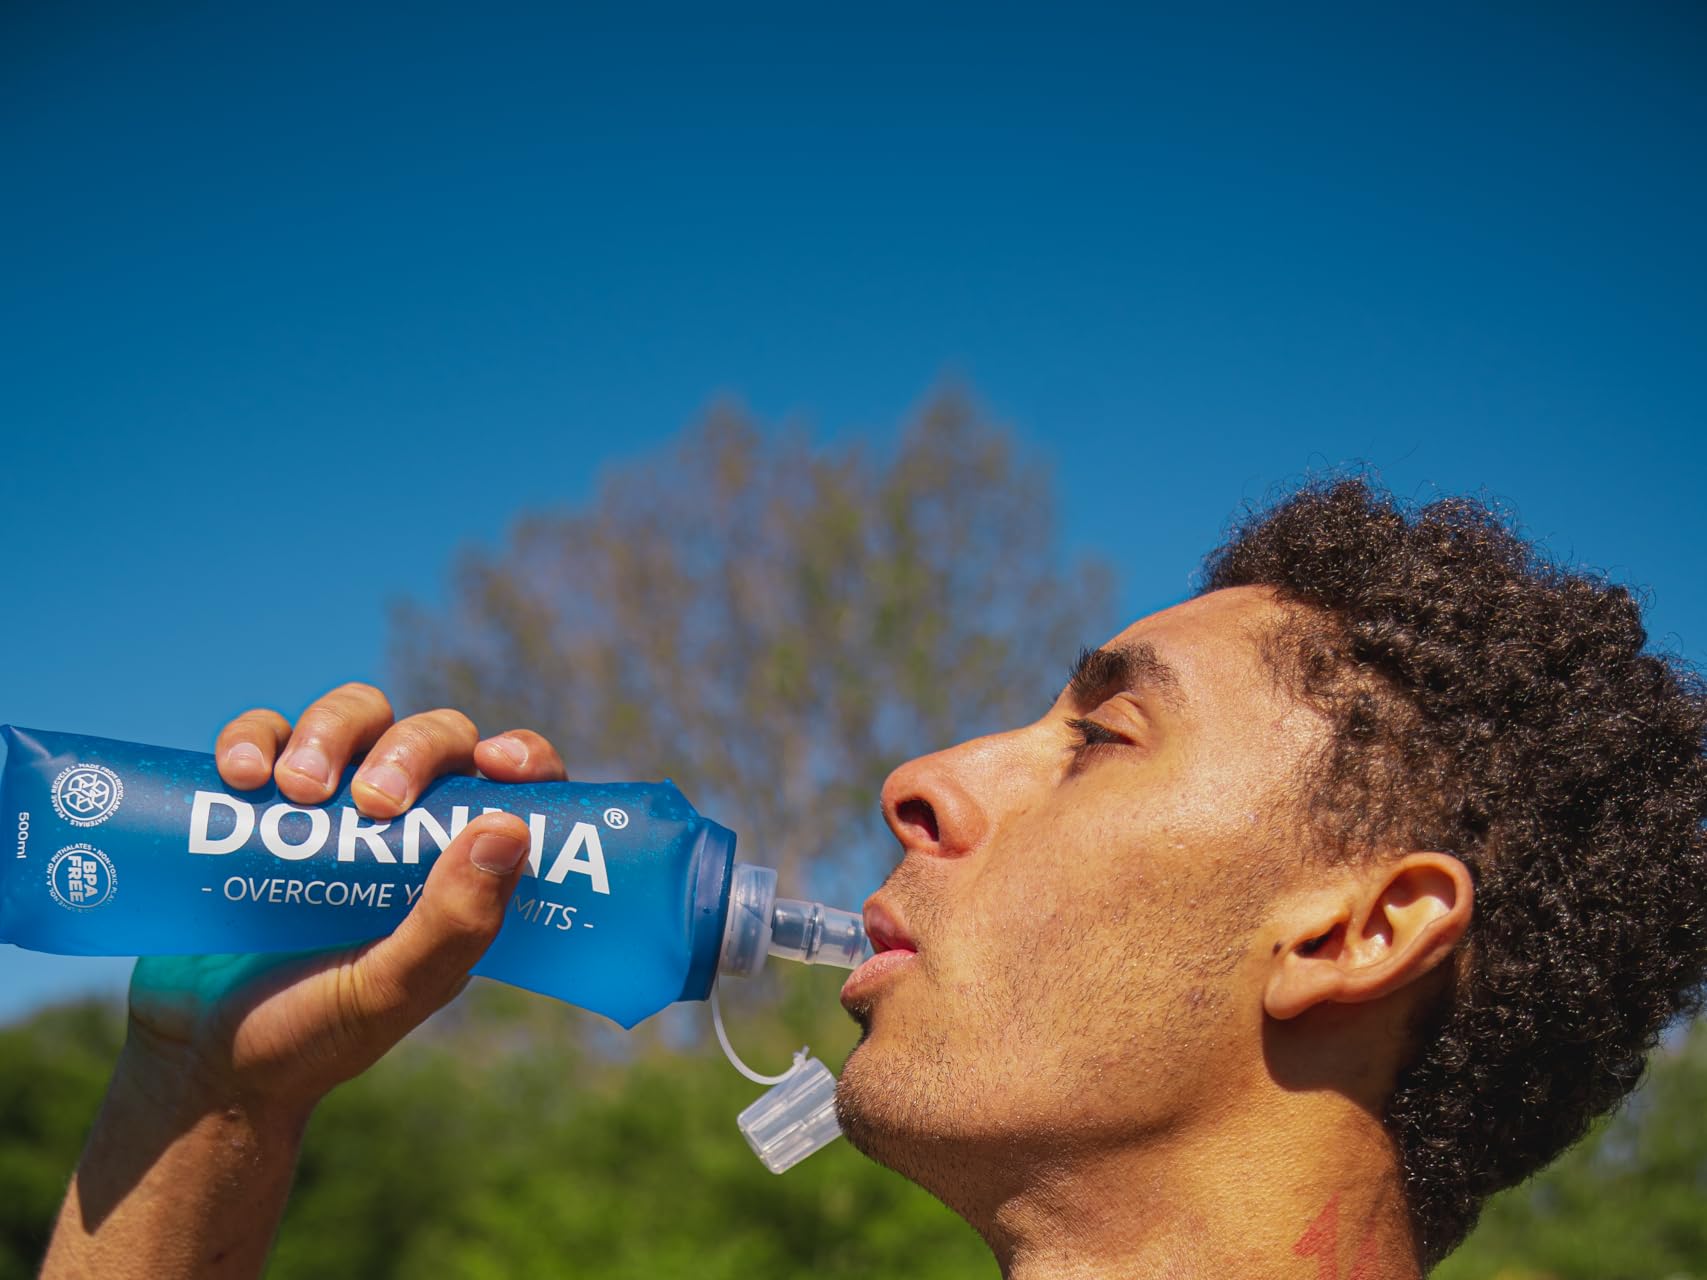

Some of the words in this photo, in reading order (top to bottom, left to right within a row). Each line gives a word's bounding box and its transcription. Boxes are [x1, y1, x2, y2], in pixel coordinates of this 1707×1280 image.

[16, 812, 30, 859] 500ml
[68, 855, 85, 902] FREE
[83, 861, 98, 897] BPA
[223, 876, 395, 908] OVERCOME
